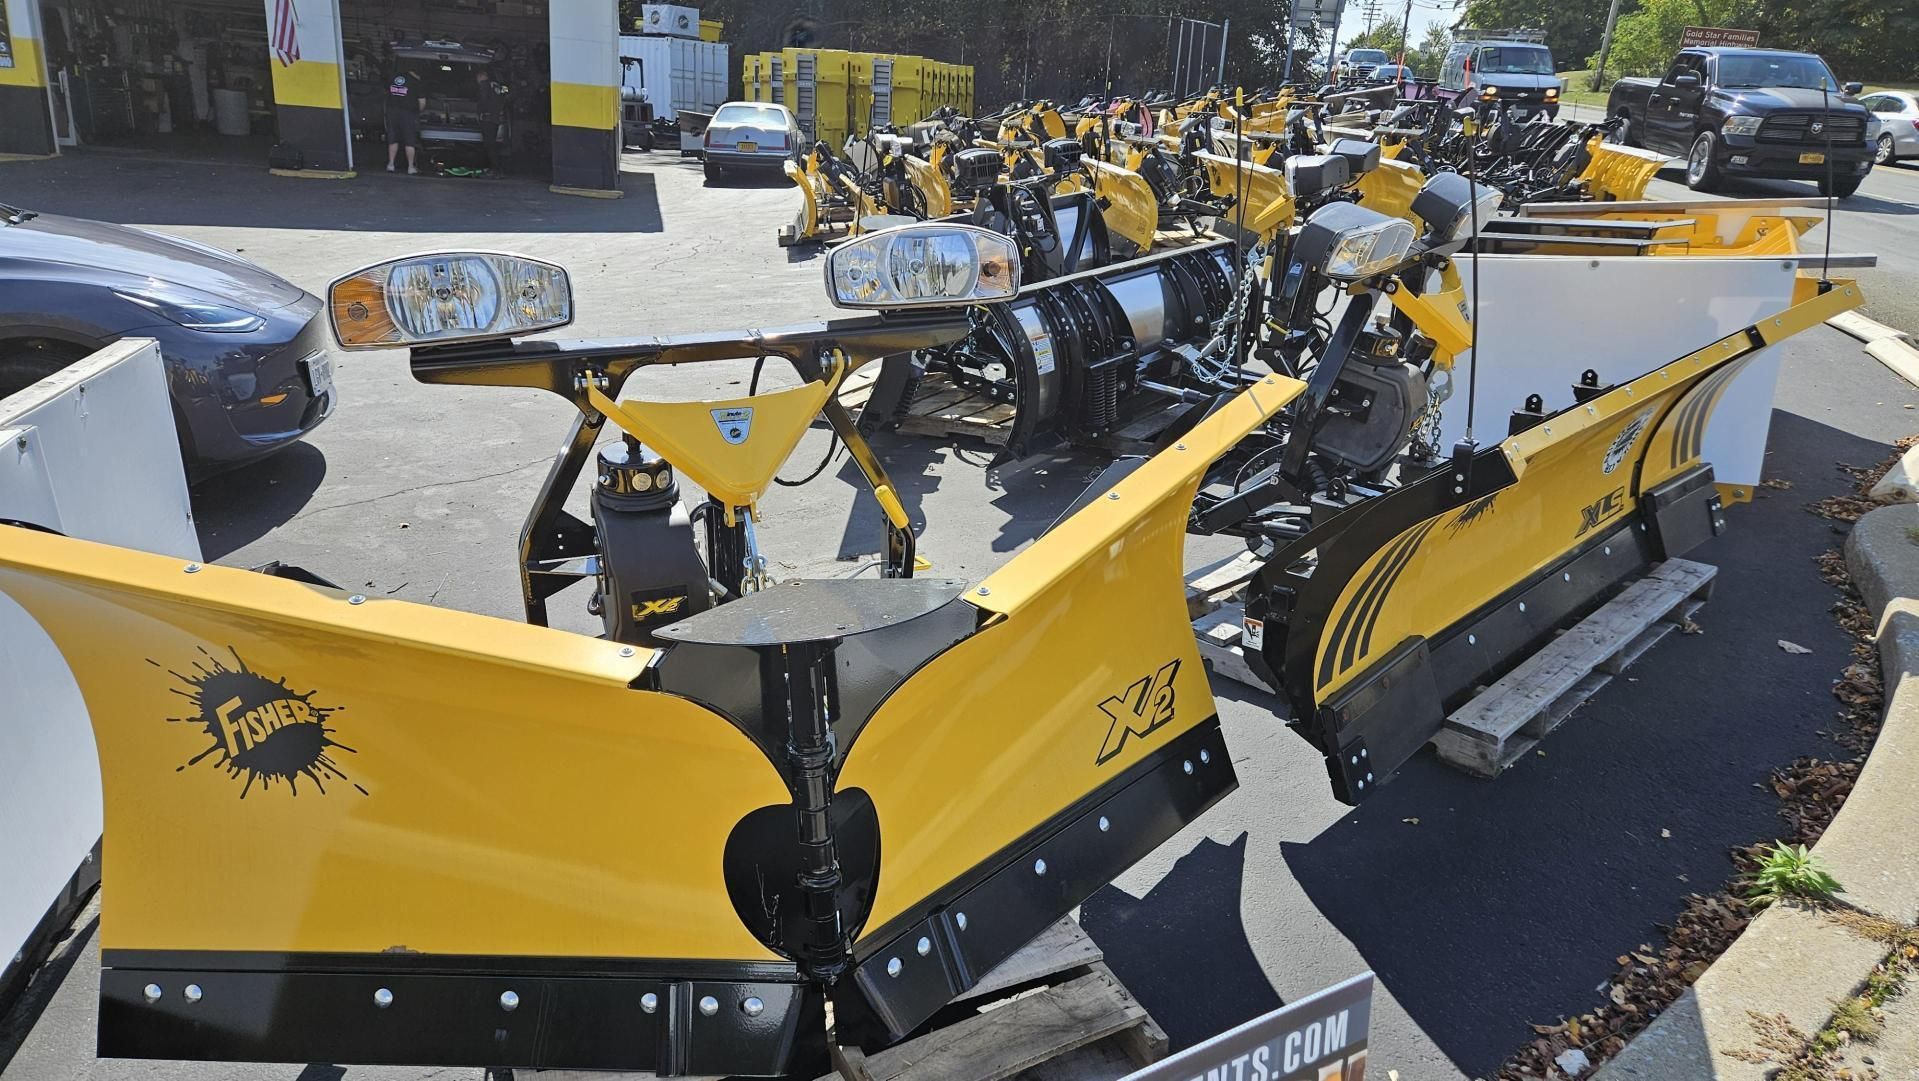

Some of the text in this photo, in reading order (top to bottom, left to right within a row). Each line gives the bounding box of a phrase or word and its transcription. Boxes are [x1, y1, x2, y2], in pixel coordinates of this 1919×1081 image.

[1683, 38, 1717, 46] Memorial
[1686, 29, 1755, 42] Gold Star Families
[215, 695, 319, 759] FISHER
